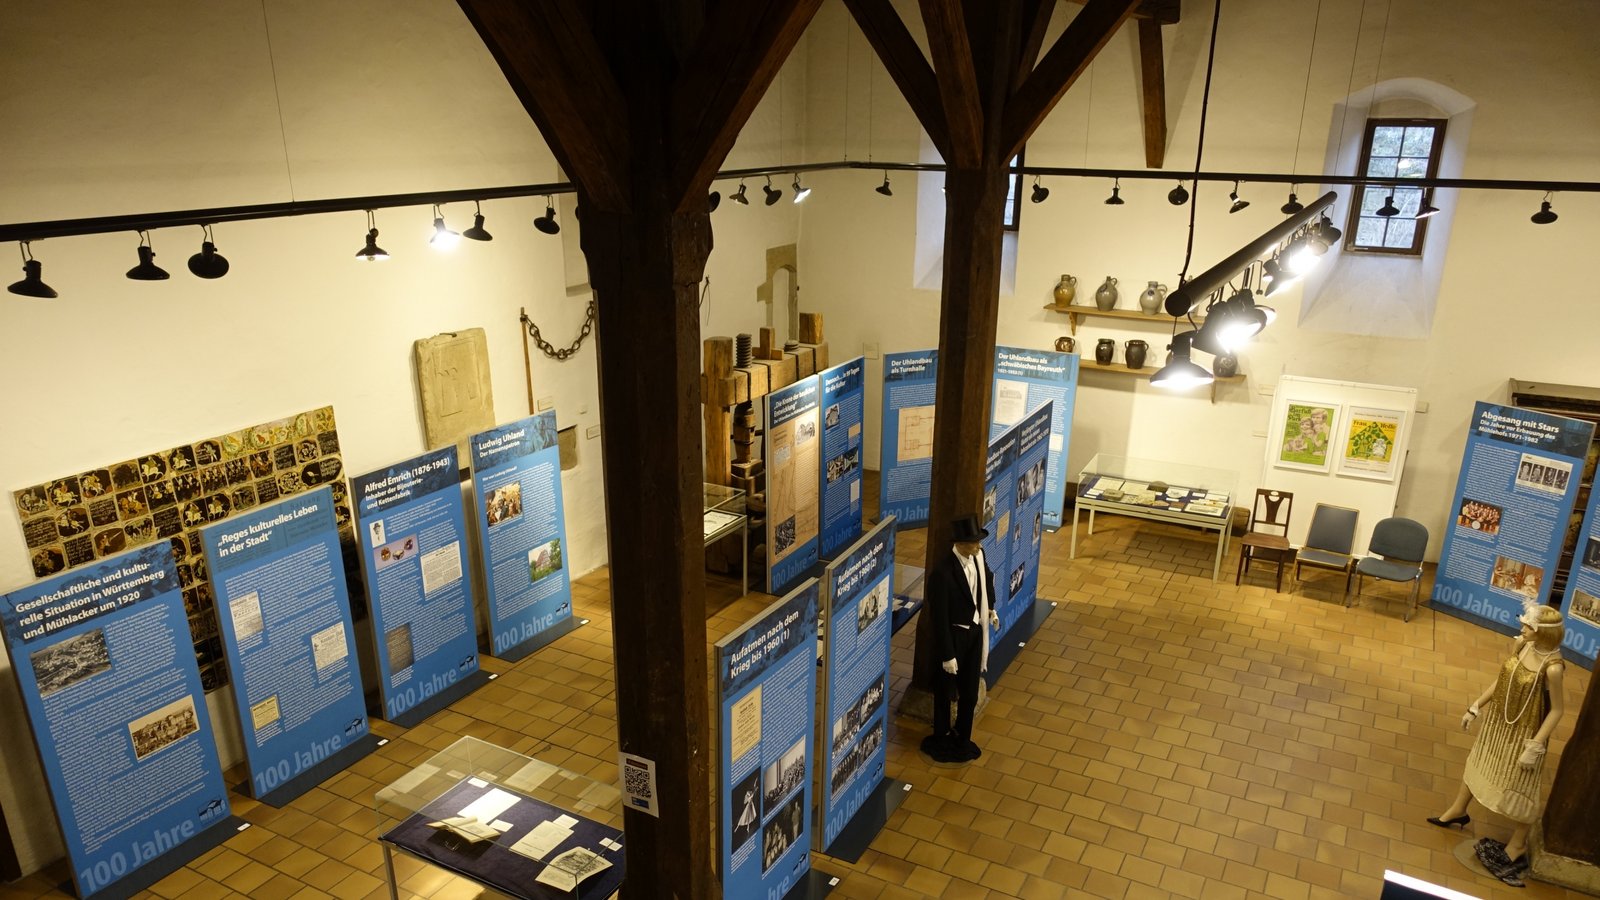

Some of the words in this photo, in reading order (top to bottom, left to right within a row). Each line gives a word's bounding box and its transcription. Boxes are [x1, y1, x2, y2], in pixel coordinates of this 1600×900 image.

[891, 366, 900, 374] als
[900, 365, 926, 373] Turnhalle
[902, 356, 932, 365] Uhlandbau
[1009, 354, 1039, 363] Uhlandbau
[1481, 411, 1521, 427] Abgesang
[1522, 420, 1537, 428] mit
[1538, 422, 1560, 433] Stars
[1490, 421, 1506, 430] Jahre
[1516, 426, 1544, 439] Erbauung
[479, 437, 502, 450] Ludwig
[502, 428, 525, 442] Uhland
[489, 440, 520, 455] Namenspatron
[365, 479, 387, 493] Alfred
[388, 470, 411, 486] Emrich
[411, 456, 450, 477] (1876-1943)
[365, 491, 387, 501] Inhaber
[387, 486, 396, 494] der
[366, 502, 378, 510] und
[379, 490, 411, 506] Kettenfabrik
[218, 528, 248, 547] „Reges
[249, 511, 293, 534] kulturelles
[294, 504, 318, 518] Leben
[904, 507, 928, 521] Jahr
[219, 548, 229, 557] in
[230, 542, 245, 554] der
[246, 530, 272, 548] Stadt“
[16, 578, 101, 613] Gesellschaftliche
[102, 570, 122, 583] und
[122, 562, 150, 576] kultu-
[773, 570, 786, 588] 100
[788, 559, 807, 579] Jahre
[837, 581, 850, 598] Krieg
[858, 565, 870, 580] 1960
[20, 613, 43, 627] relle
[44, 597, 90, 617] Situation
[92, 593, 101, 601] in
[102, 569, 165, 598] Württemberg
[1435, 584, 1462, 606] 100
[1464, 593, 1510, 623] Jahre
[23, 625, 45, 640] und
[46, 608, 98, 632] Mühlacker
[99, 602, 116, 612] um
[117, 591, 140, 605] 1920
[495, 627, 518, 652] 100
[520, 613, 553, 642] Jahre
[730, 632, 766, 666] Aufatmen
[767, 618, 784, 639] nach
[784, 610, 799, 627] dem
[1564, 628, 1584, 654] 00
[730, 659, 750, 679] Krieg
[751, 647, 762, 662] bis
[763, 637, 780, 654] 1960
[780, 629, 790, 644] (1)
[388, 688, 415, 717] 100
[418, 667, 456, 702] Jahre
[255, 759, 290, 793] 100
[294, 734, 342, 772] Jahre
[825, 815, 844, 847] 100
[845, 782, 870, 822] Jahre
[81, 852, 127, 893] 100
[132, 817, 194, 868] Jahre
[768, 875, 790, 900] hre
